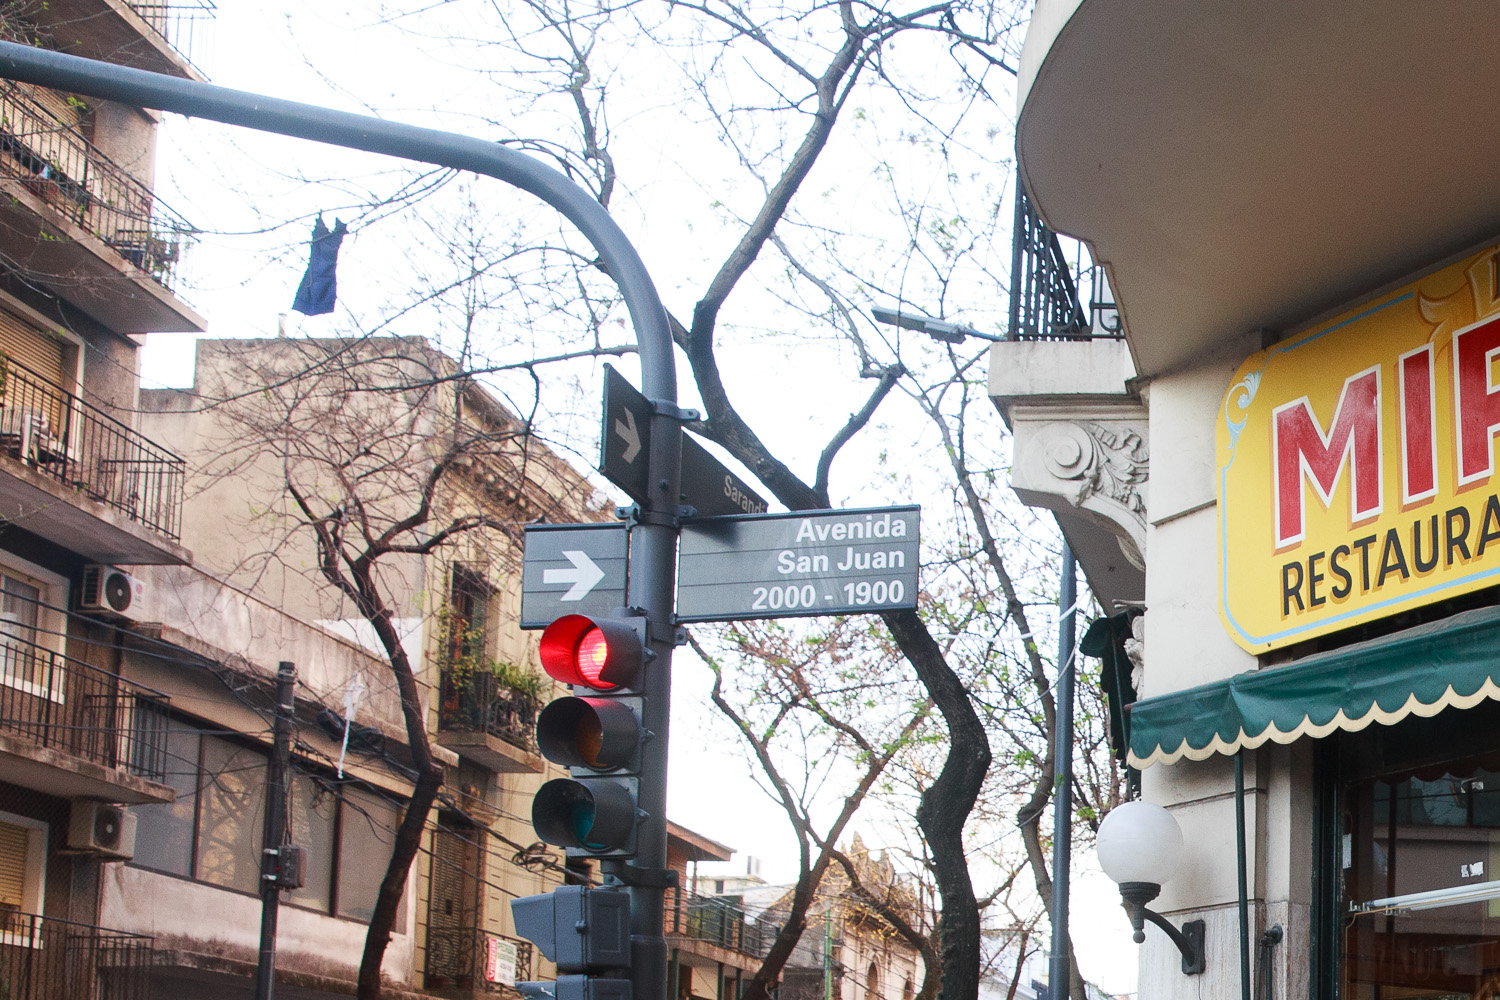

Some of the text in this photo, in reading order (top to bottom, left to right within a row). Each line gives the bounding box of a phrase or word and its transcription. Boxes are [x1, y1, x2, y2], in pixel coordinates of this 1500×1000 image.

[796, 515, 907, 542] Avenida
[777, 545, 905, 574] San Juan
[752, 580, 904, 610] 2000 1900
